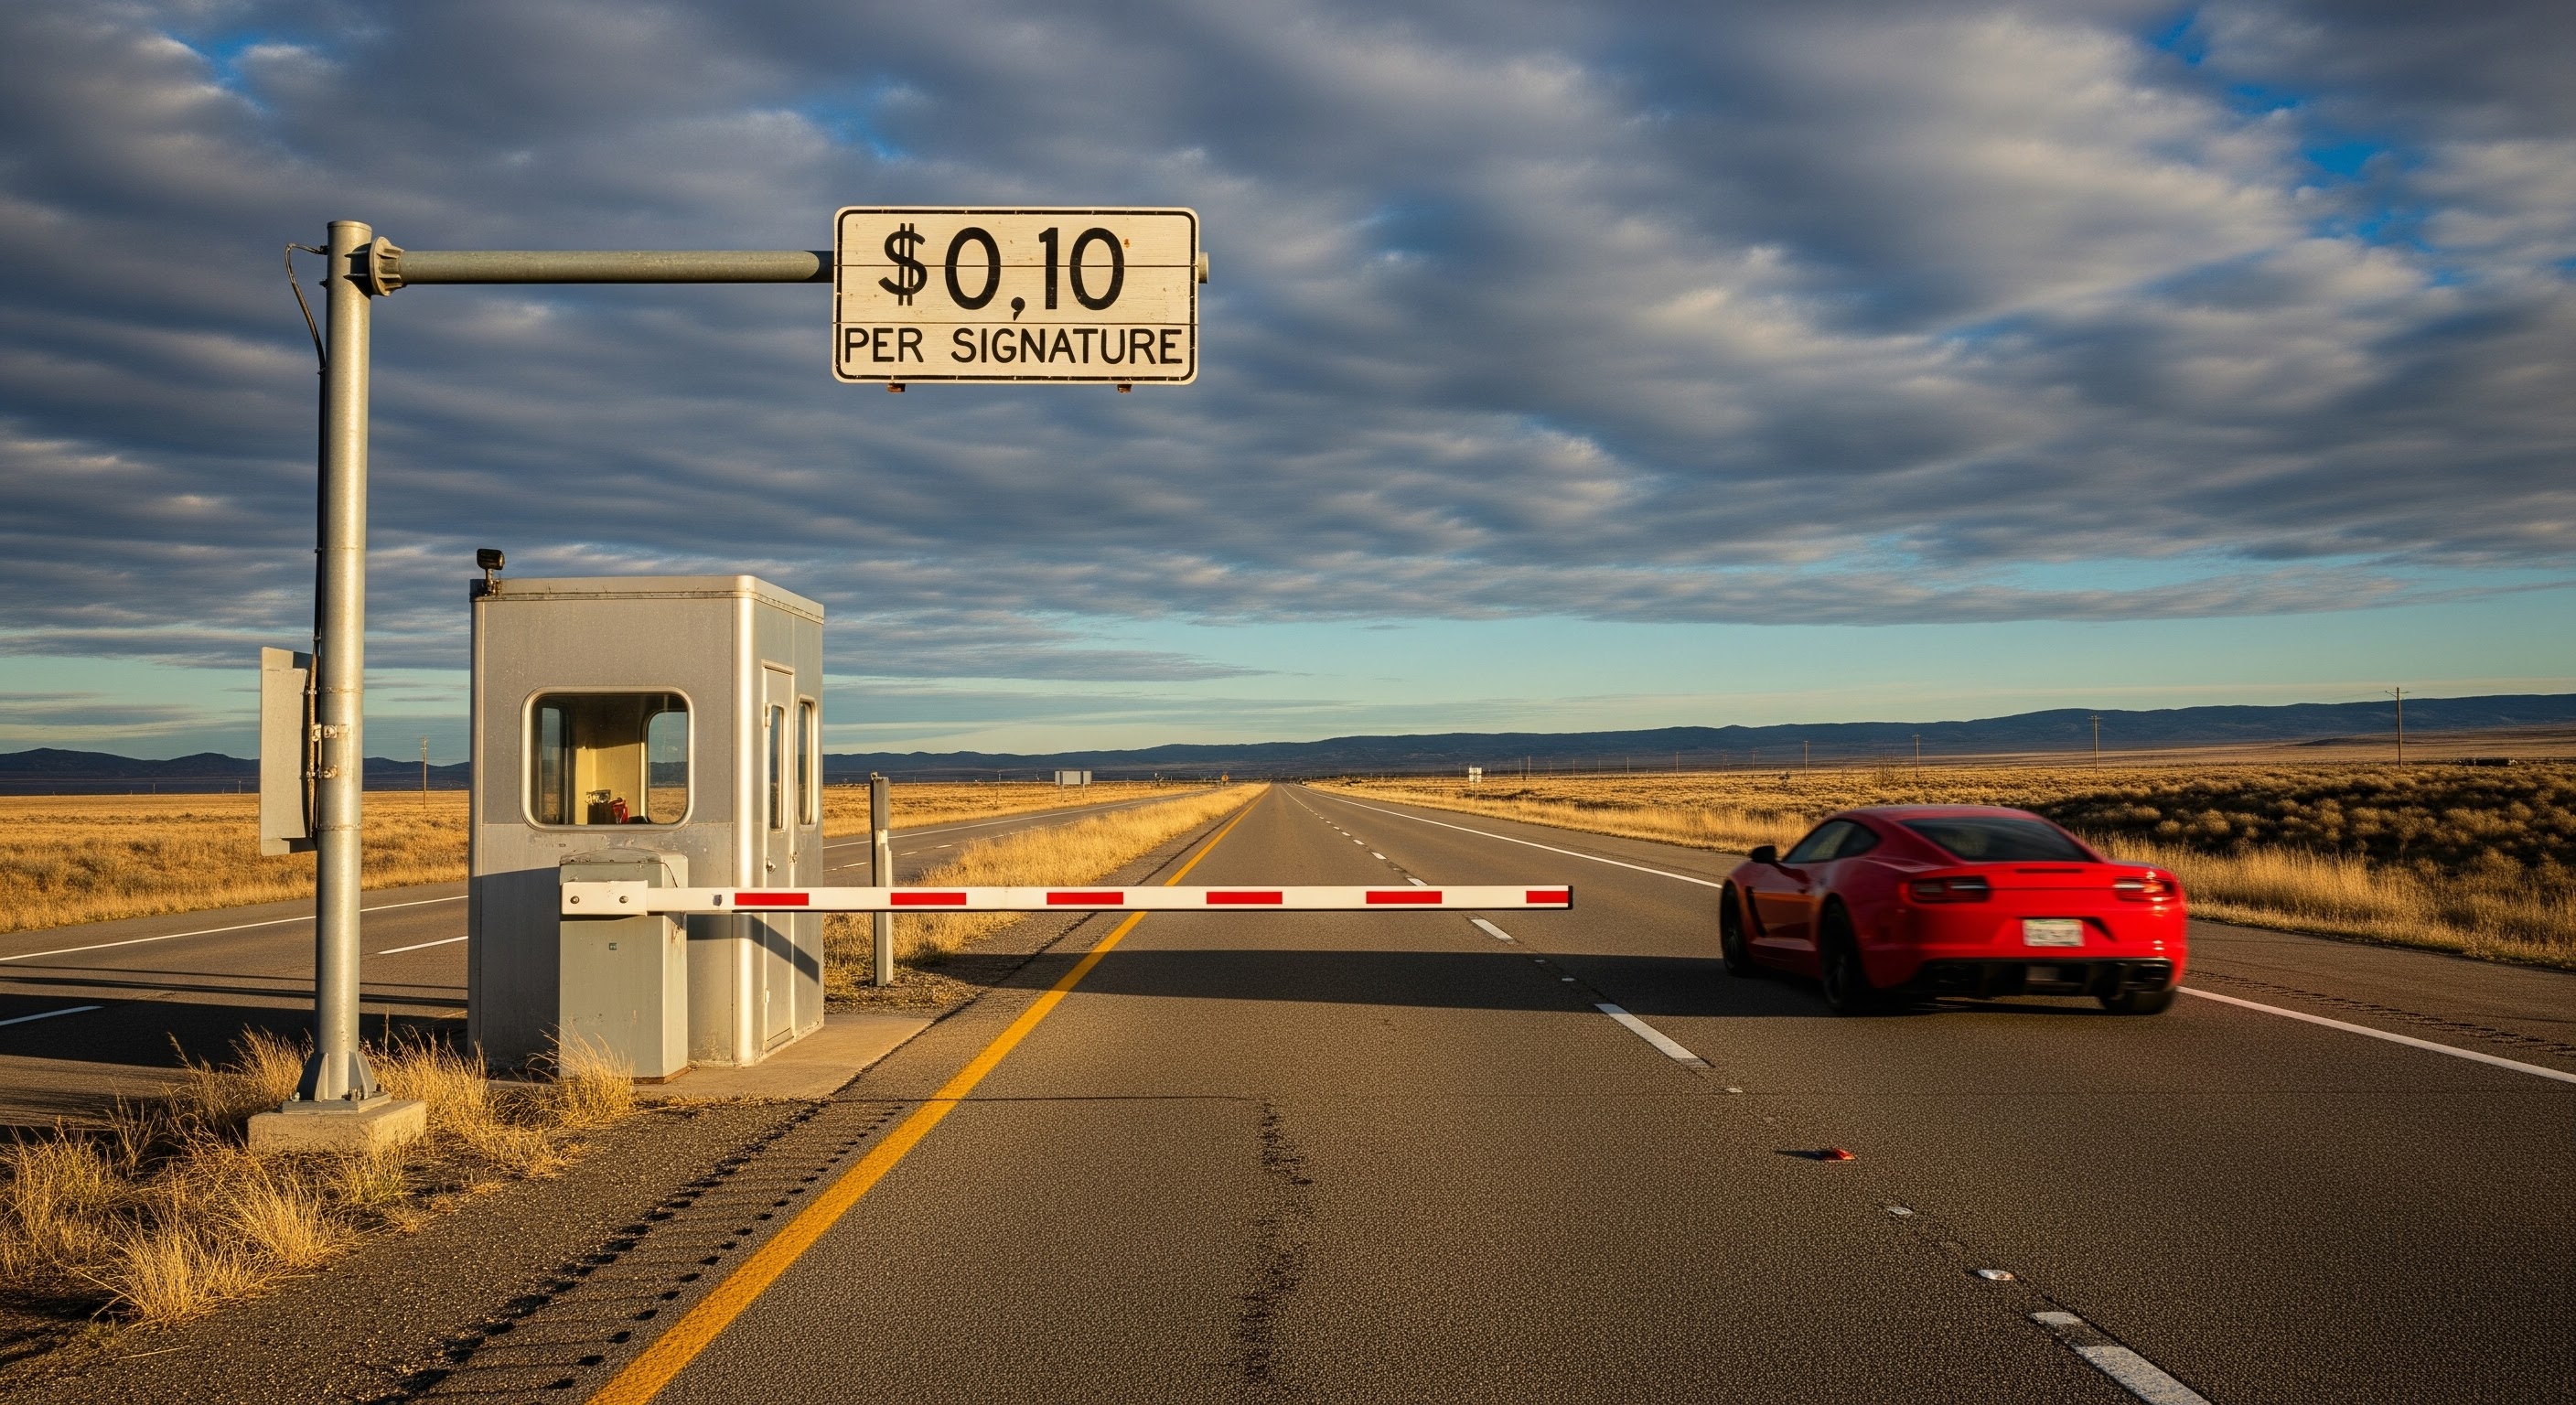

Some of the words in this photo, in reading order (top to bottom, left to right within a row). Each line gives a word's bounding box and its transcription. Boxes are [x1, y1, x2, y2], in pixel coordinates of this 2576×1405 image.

[878, 222, 1125, 321] $0,10
[844, 327, 924, 363] PER
[950, 327, 1183, 365] SIGNATURE
